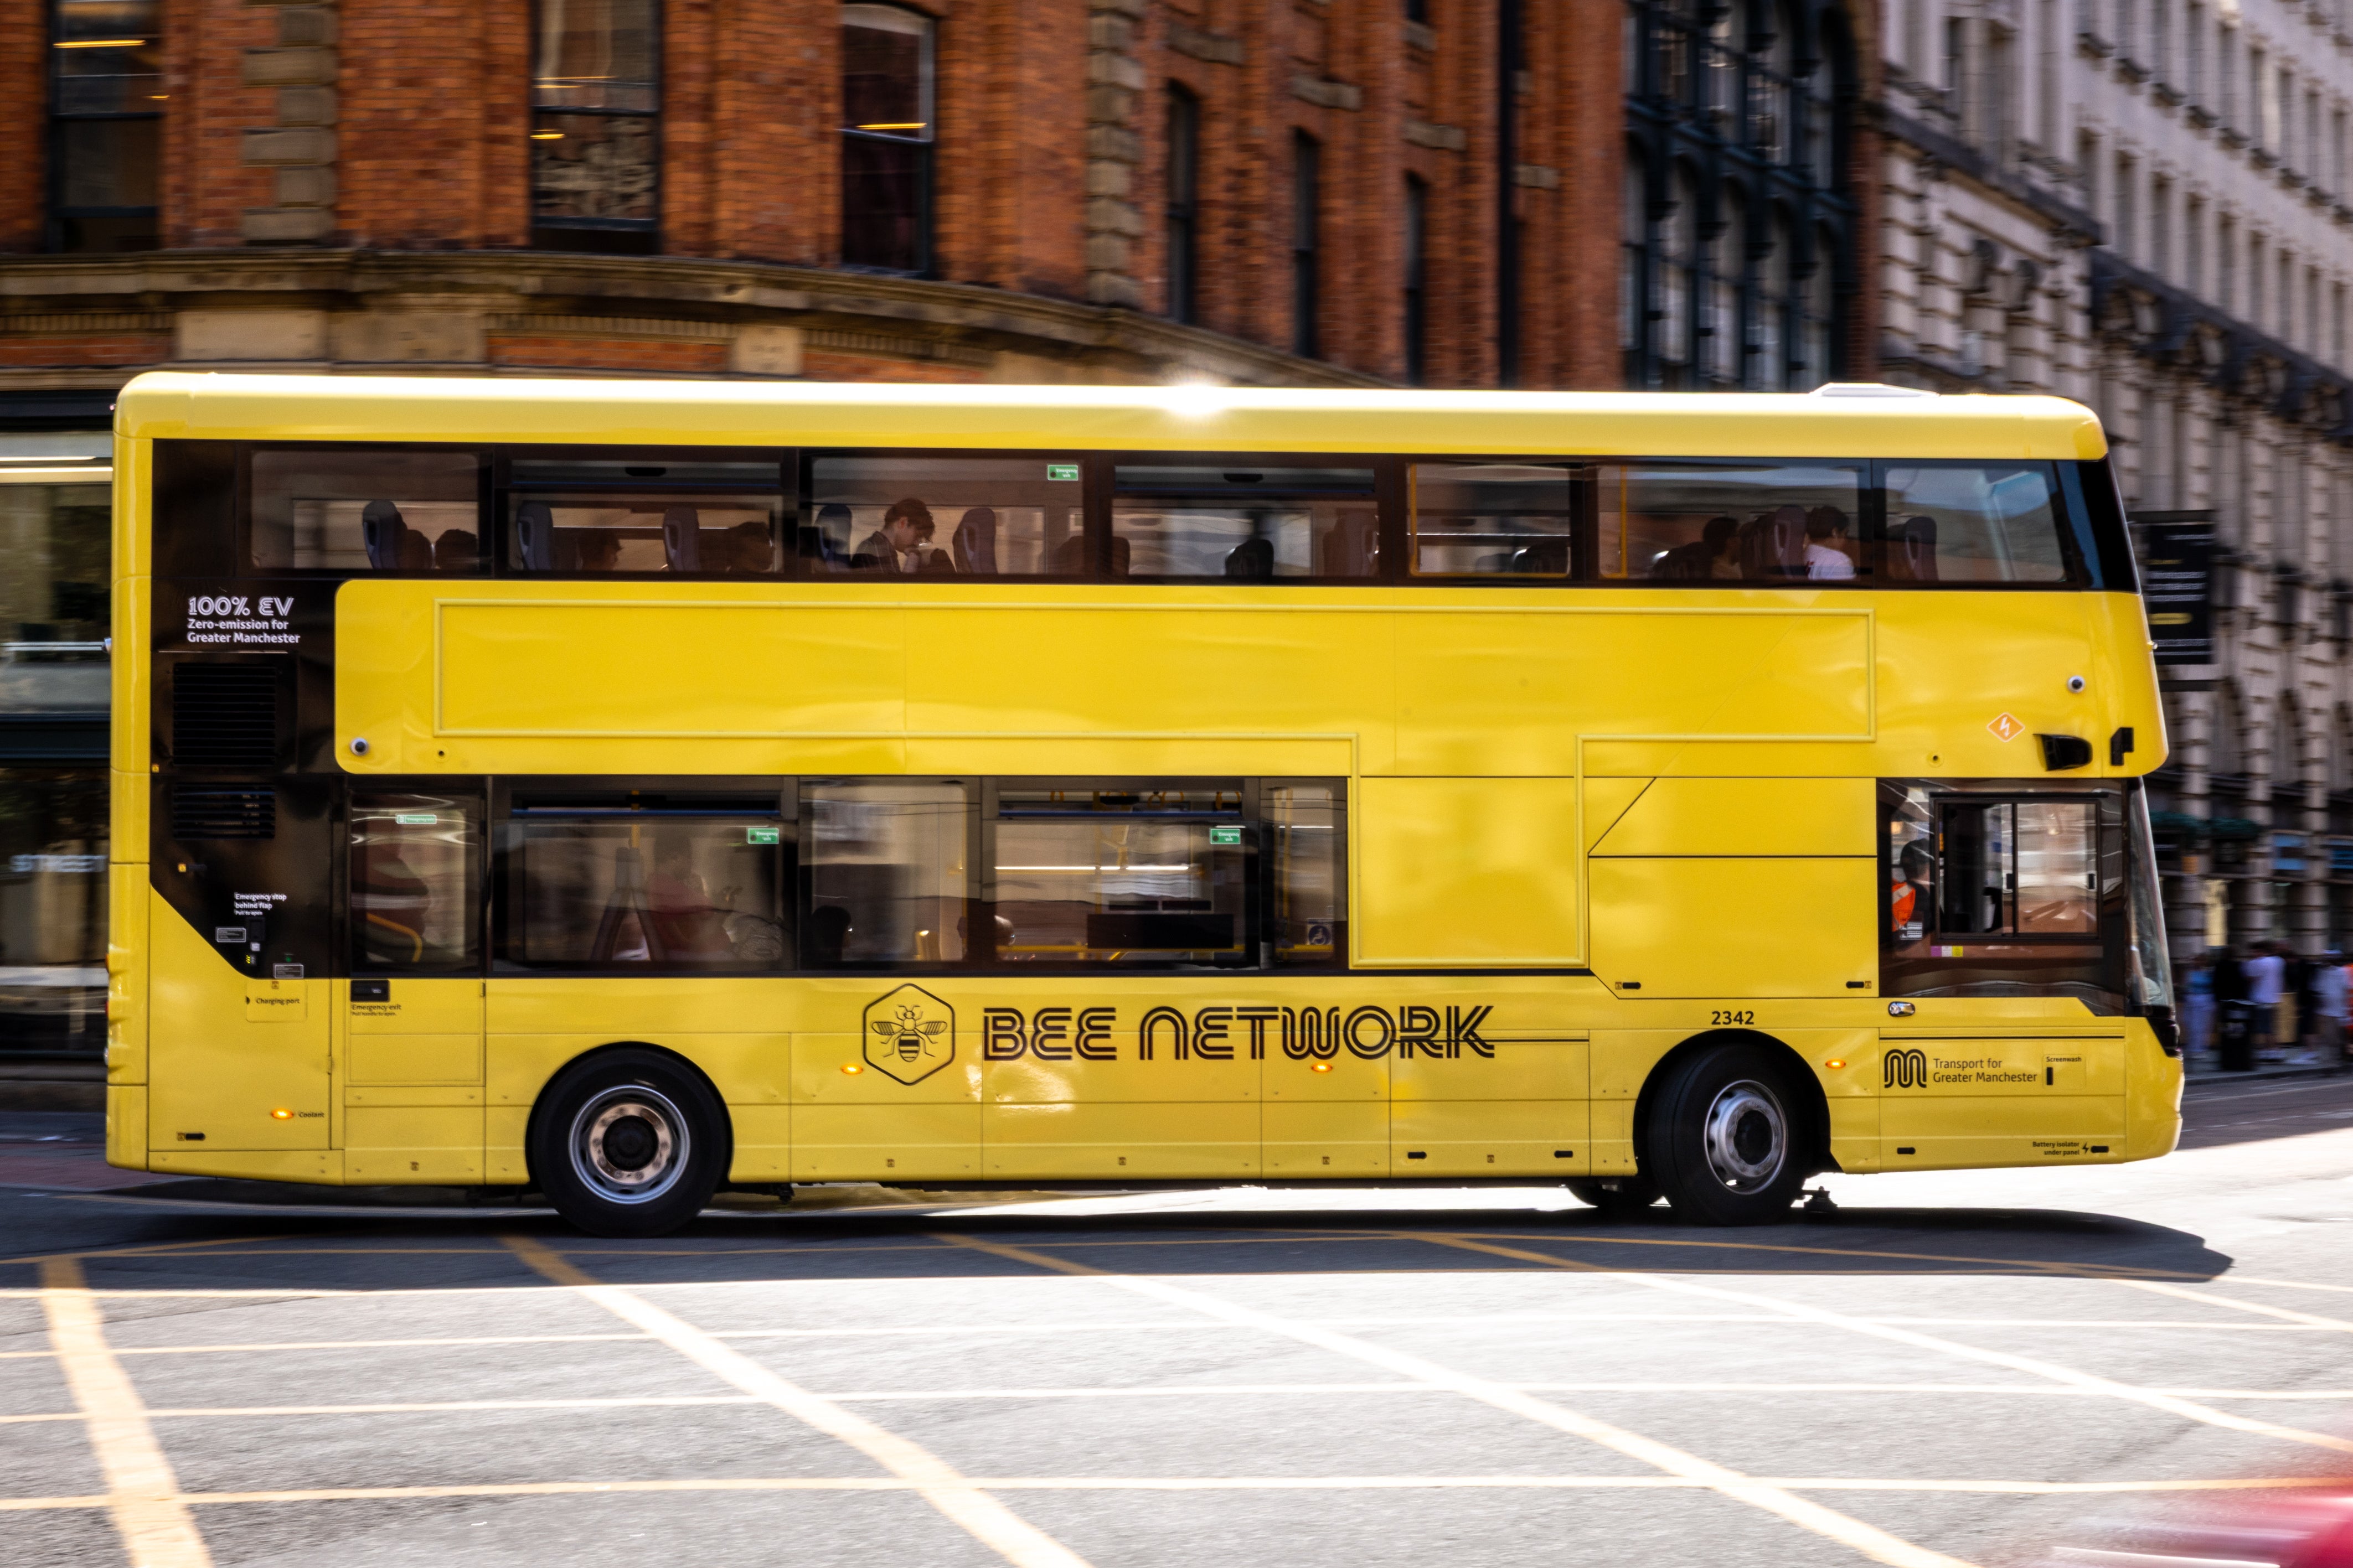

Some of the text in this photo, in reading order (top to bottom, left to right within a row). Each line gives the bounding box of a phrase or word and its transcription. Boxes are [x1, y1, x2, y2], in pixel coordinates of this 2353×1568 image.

[188, 596, 294, 616] 100% EV
[187, 618, 289, 629] Zero-emission for
[187, 632, 300, 643] Greater Manchester
[234, 892, 287, 902] Emergency stop
[259, 901, 273, 910] flap
[256, 997, 285, 1006] Charging
[1711, 1011, 1755, 1025] 2342
[983, 1005, 1495, 1061] BEE NETWORK
[1933, 1056, 2003, 1071] Transport for
[2046, 1054, 2082, 1063] Screenwash
[1933, 1072, 2037, 1083] Greater Manchester
